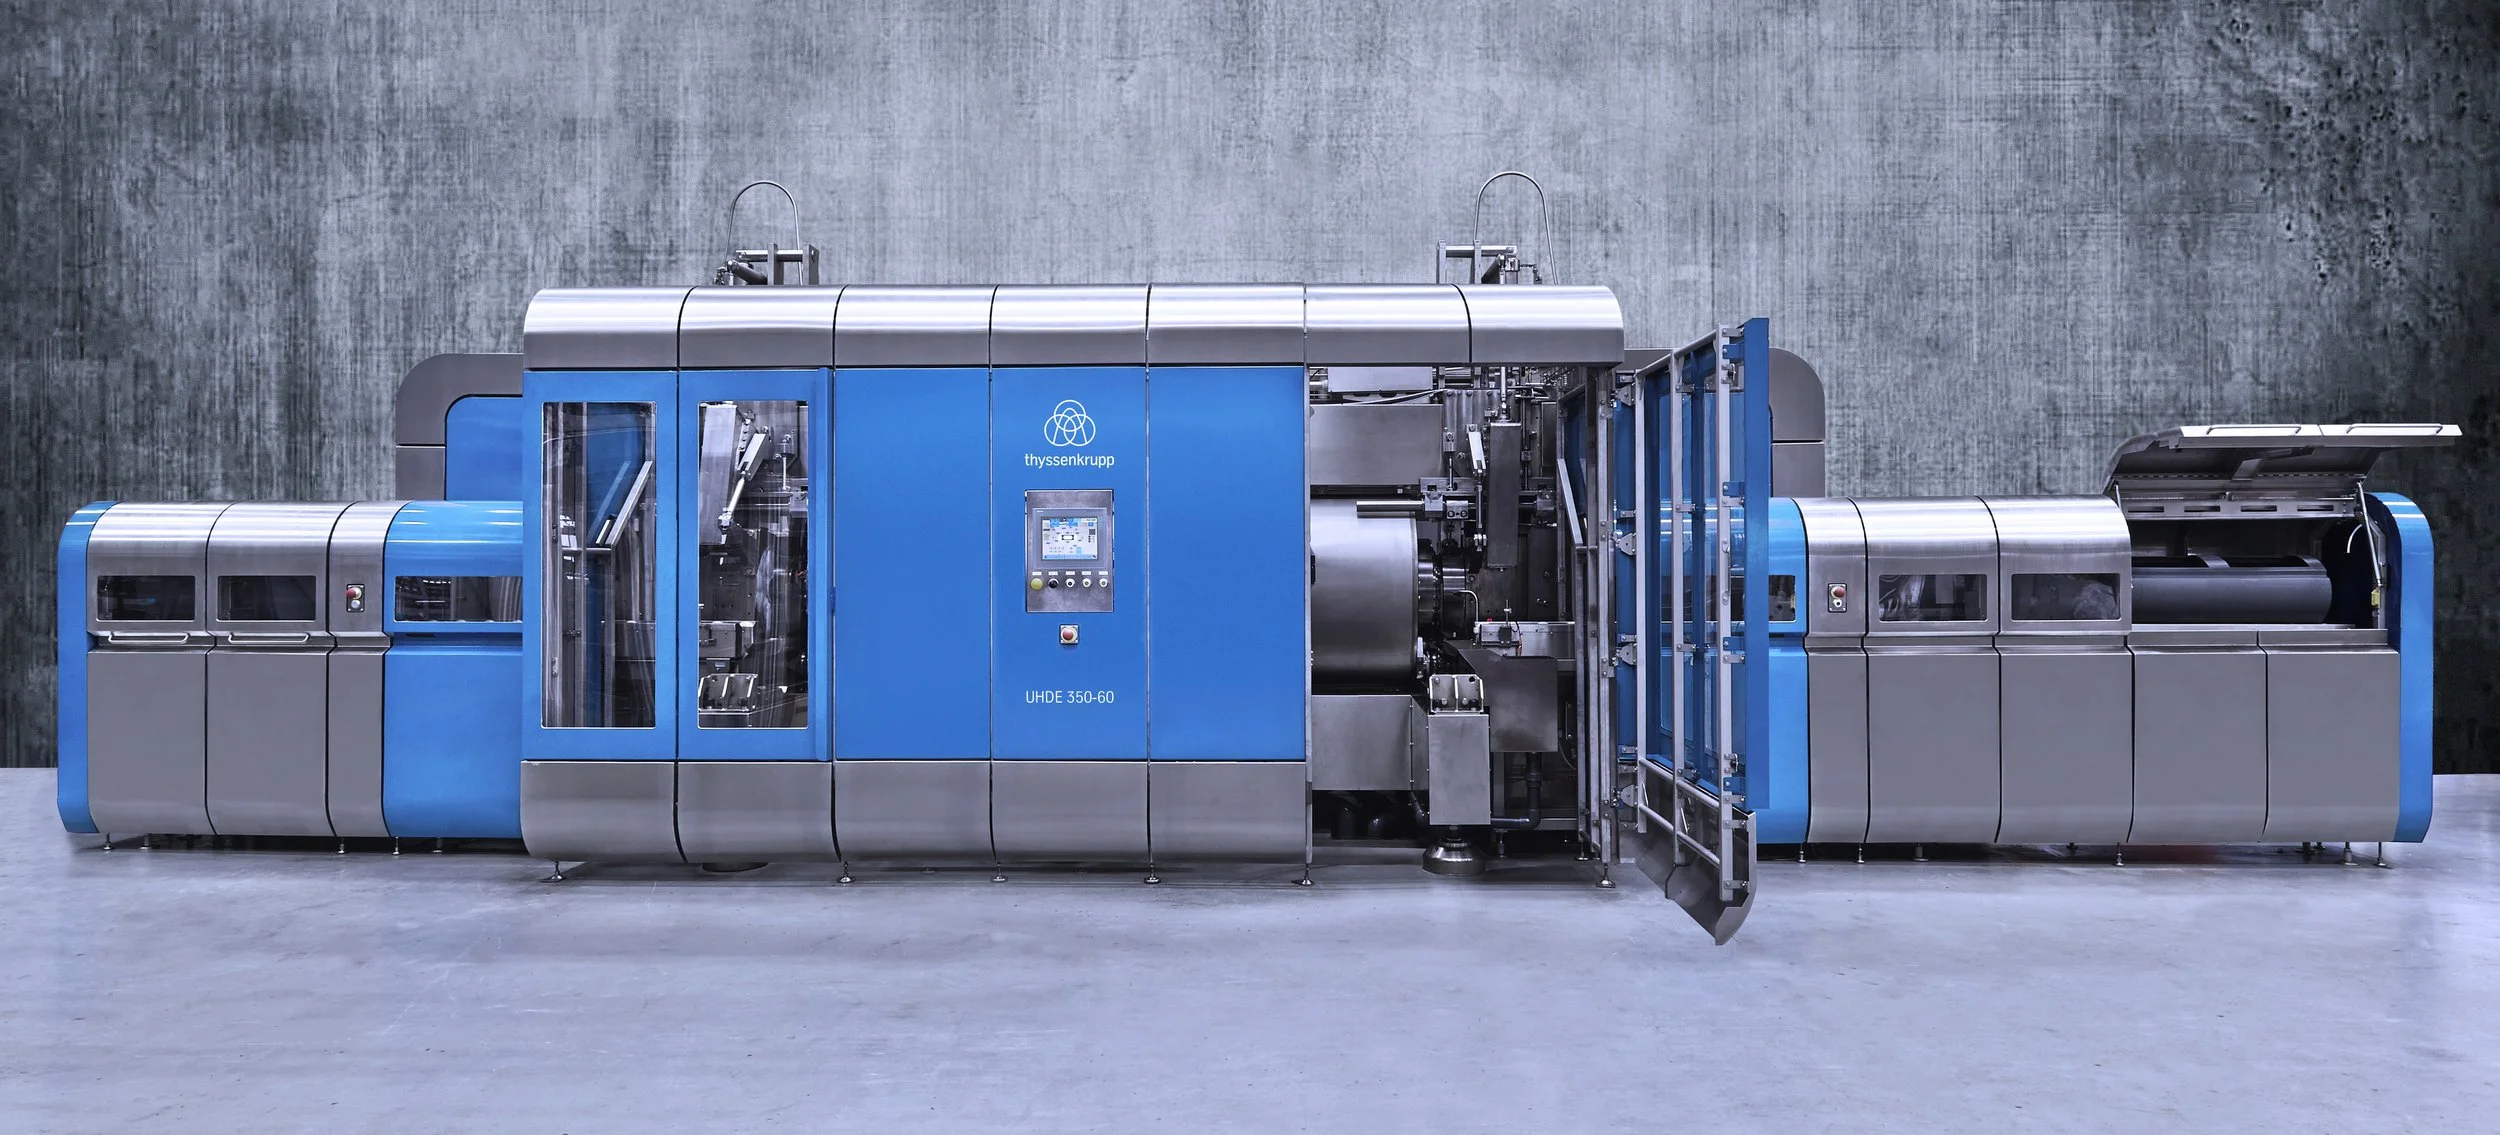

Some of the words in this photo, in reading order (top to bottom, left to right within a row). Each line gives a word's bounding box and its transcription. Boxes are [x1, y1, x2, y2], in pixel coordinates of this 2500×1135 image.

[1024, 452, 1115, 469] thyssenkrupp
[1025, 690, 1063, 704] UHDE
[1066, 690, 1115, 704] 350-60
